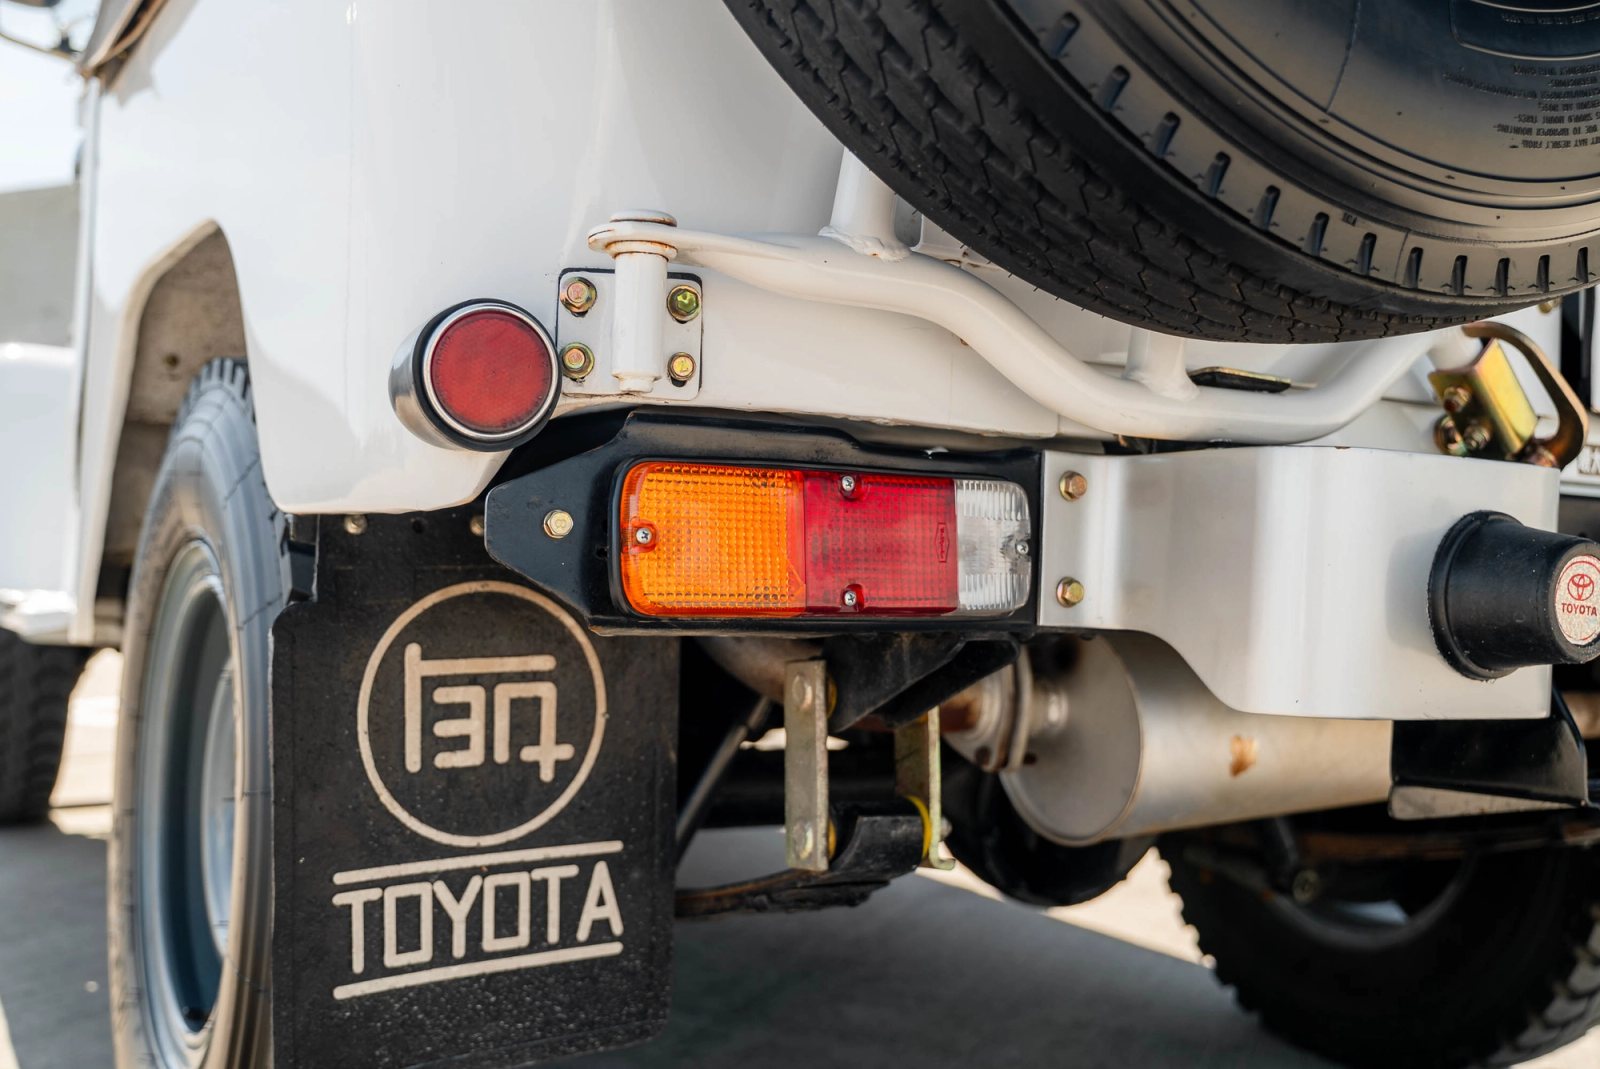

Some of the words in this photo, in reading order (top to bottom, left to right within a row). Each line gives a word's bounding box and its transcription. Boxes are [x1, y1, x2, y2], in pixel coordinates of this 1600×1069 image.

[1572, 126, 1581, 135] TO
[1545, 140, 1571, 149] RESULT
[1561, 602, 1597, 616] TOYOTA
[332, 861, 624, 974] TOYOTA
